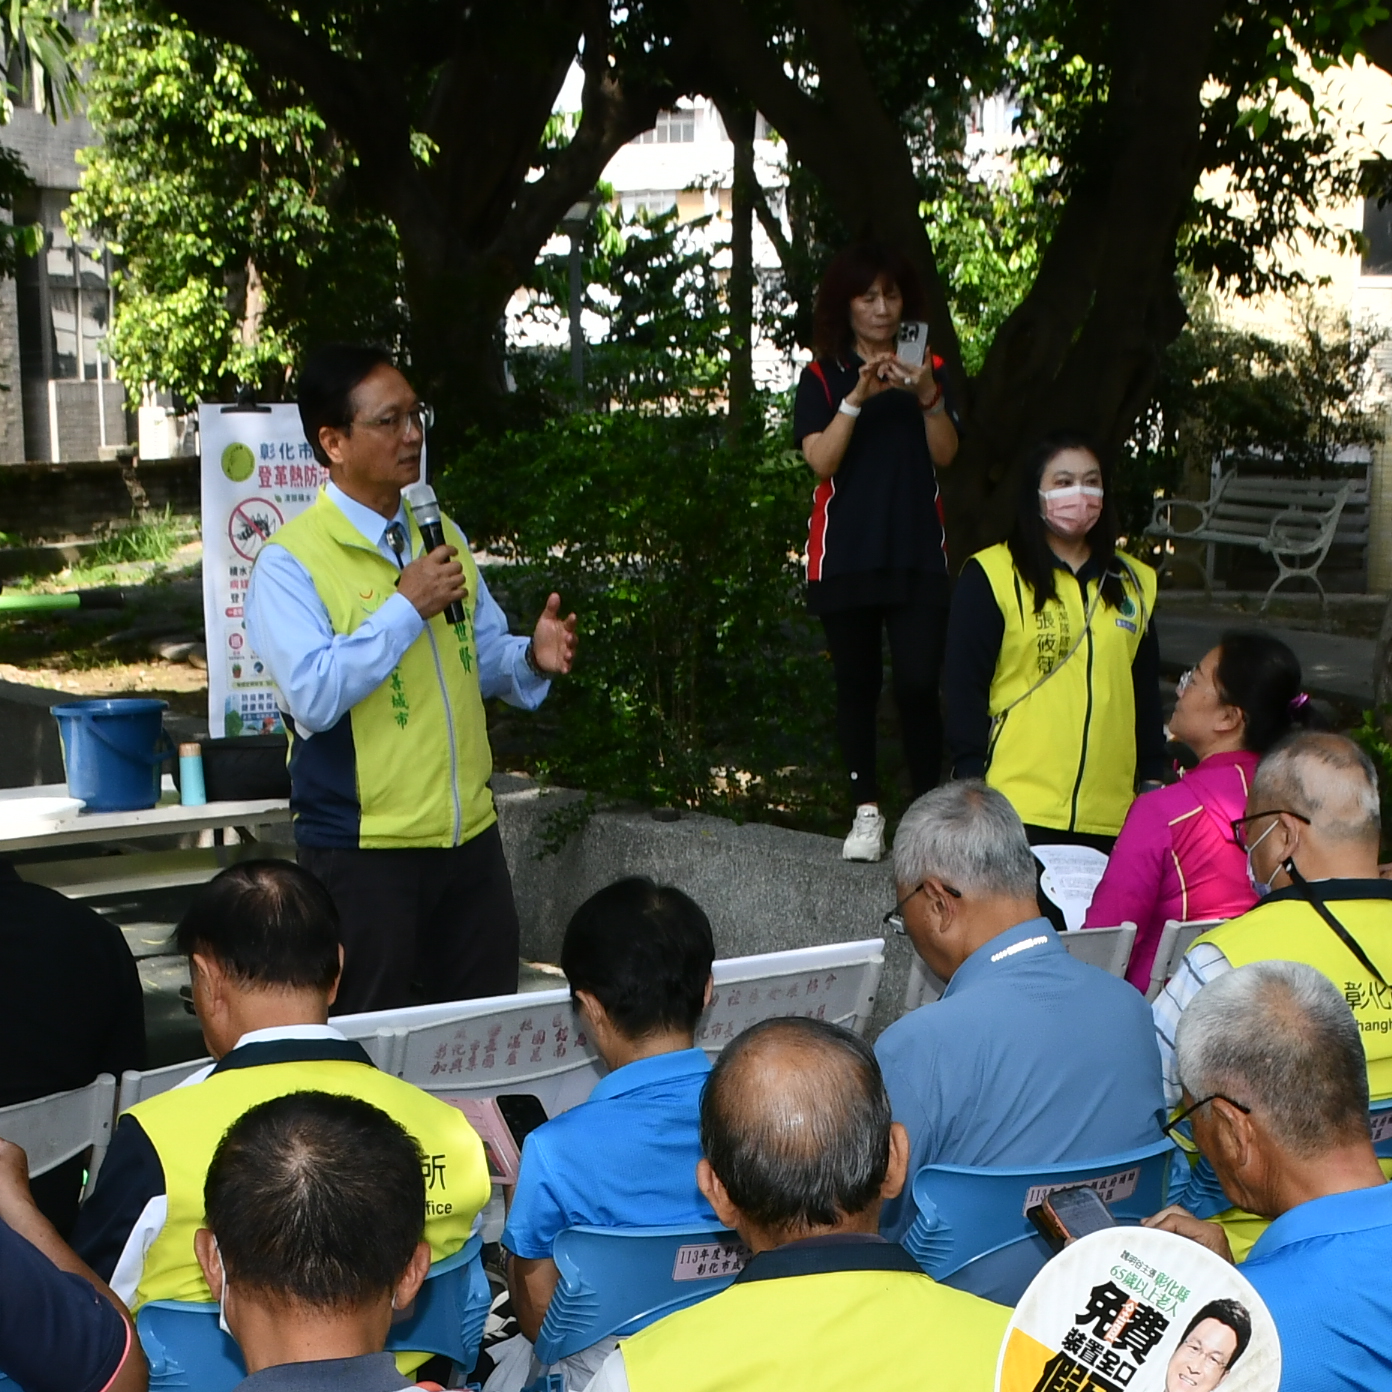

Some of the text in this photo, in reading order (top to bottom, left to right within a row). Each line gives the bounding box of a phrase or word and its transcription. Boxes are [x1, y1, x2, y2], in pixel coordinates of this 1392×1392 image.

[260, 442, 313, 460] 彰化市
[1109, 1265, 1180, 1317] 65歲以上老人
[1155, 1271, 1191, 1304] 彰化縣
[1075, 1280, 1170, 1366] 免費
